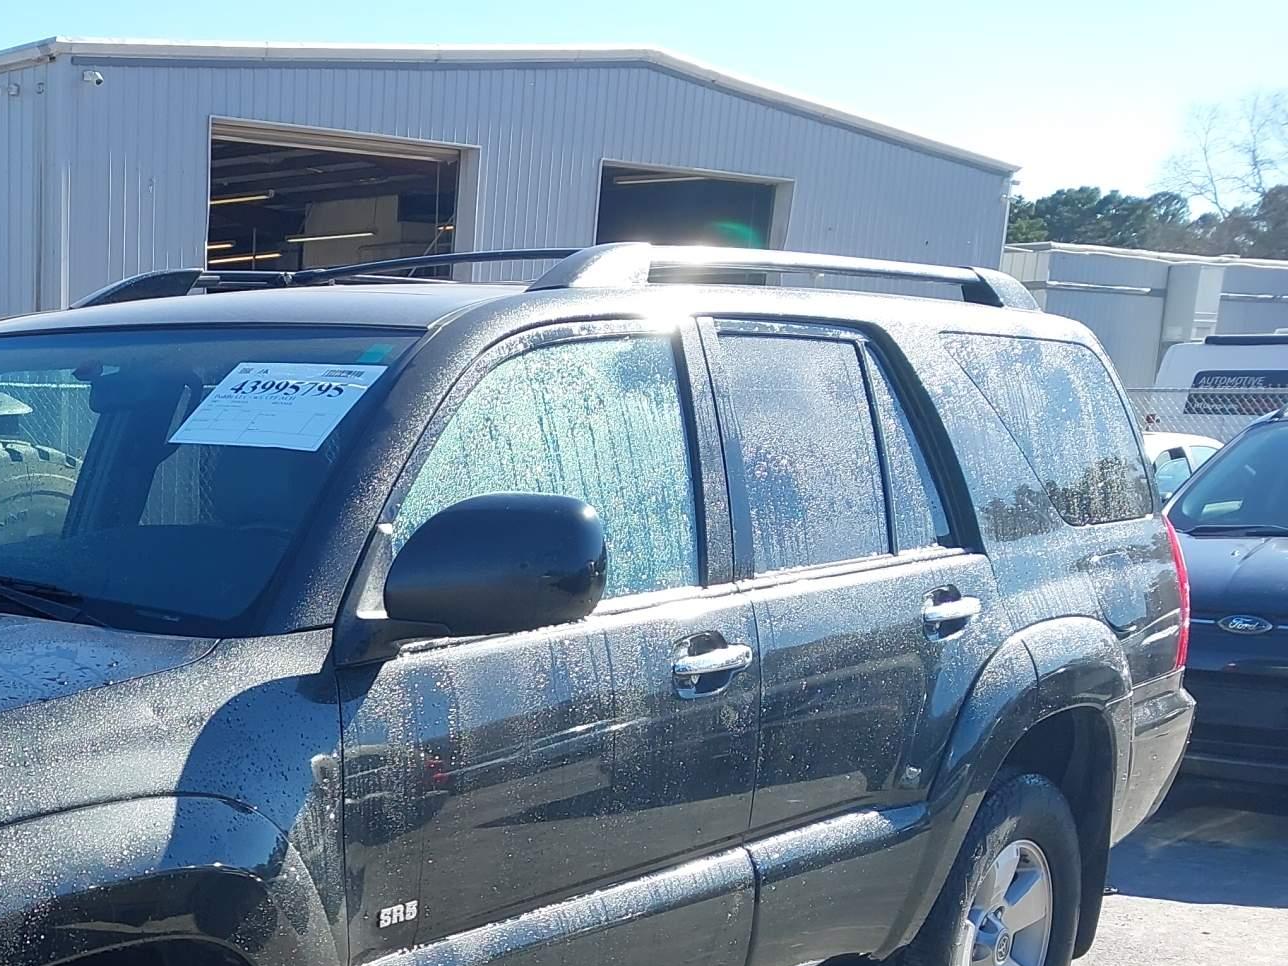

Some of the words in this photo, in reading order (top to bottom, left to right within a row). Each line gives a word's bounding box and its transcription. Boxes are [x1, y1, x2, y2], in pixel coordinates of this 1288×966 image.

[1199, 376, 1266, 385] AUTOMOTIVE
[230, 380, 347, 398] 43995795
[1228, 617, 1260, 631] Ford
[379, 900, 418, 929] SR5
